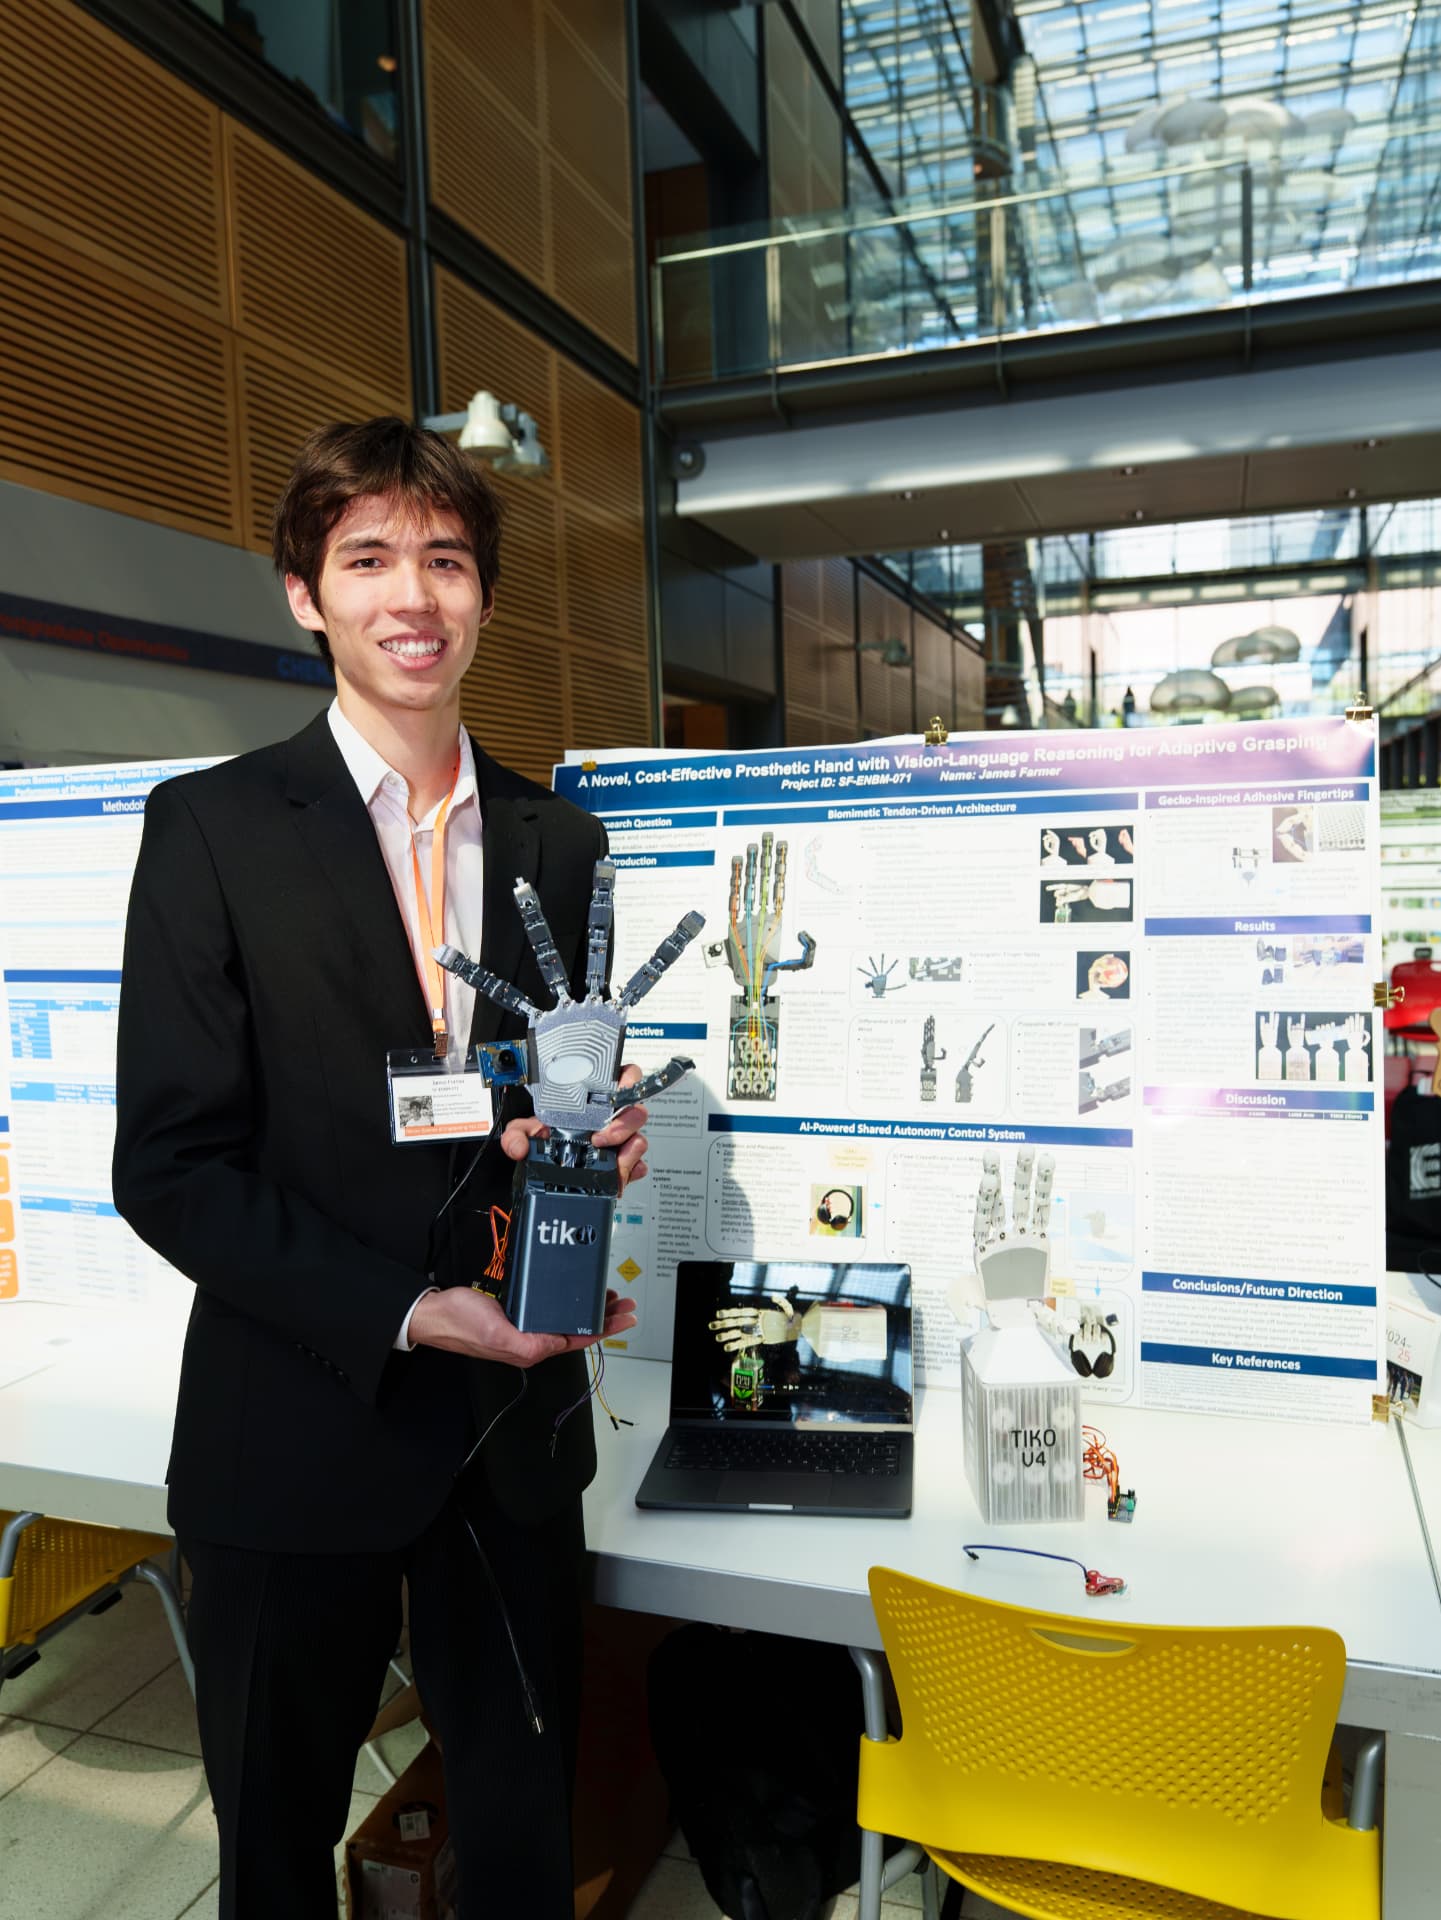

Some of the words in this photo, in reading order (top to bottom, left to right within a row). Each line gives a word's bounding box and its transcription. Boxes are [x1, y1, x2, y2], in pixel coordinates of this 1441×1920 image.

[577, 775, 588, 788] A
[591, 772, 632, 787] Novel,
[635, 765, 732, 784] Cost-Effective
[736, 760, 810, 778] Prosthetic
[814, 758, 854, 774] Hand
[858, 756, 890, 771] with
[895, 750, 1029, 769] Vision-Language
[1034, 744, 1124, 762] Reasoning
[1129, 743, 1152, 758] for
[1158, 738, 1238, 757] Adaptive
[1243, 734, 1328, 753] Grasping
[781, 776, 818, 790] Project
[821, 776, 836, 788] ID:
[838, 773, 912, 787] SF-ENBM-071
[940, 769, 976, 782] Name:
[979, 767, 1017, 780] James
[1019, 765, 1062, 779] Farmer
[1158, 793, 1239, 806] Gecko-Inspired
[1243, 791, 1295, 804] Adhesive
[1297, 788, 1355, 802] Fingertips
[827, 808, 880, 820] Biomimetic
[883, 805, 953, 817] Tendon-Driven
[955, 802, 1017, 814] Architecture
[603, 818, 633, 829] search
[634, 817, 673, 829] Question
[613, 856, 657, 867] troduction
[1235, 921, 1276, 932] Results
[626, 1026, 664, 1037] bjectives
[1226, 1093, 1287, 1105] Discussion
[799, 1121, 855, 1134] AI-Powered
[858, 1124, 892, 1135] Shared
[893, 1125, 946, 1138] Autonomy
[948, 1127, 986, 1138] Control
[988, 1129, 1026, 1141] System
[1172, 1278, 1285, 1297] Conclusions/Future
[1287, 1285, 1343, 1301] Direction
[1212, 1353, 1233, 1367] Key
[1236, 1355, 1301, 1371] References
[1010, 1429, 1057, 1448] TIKO
